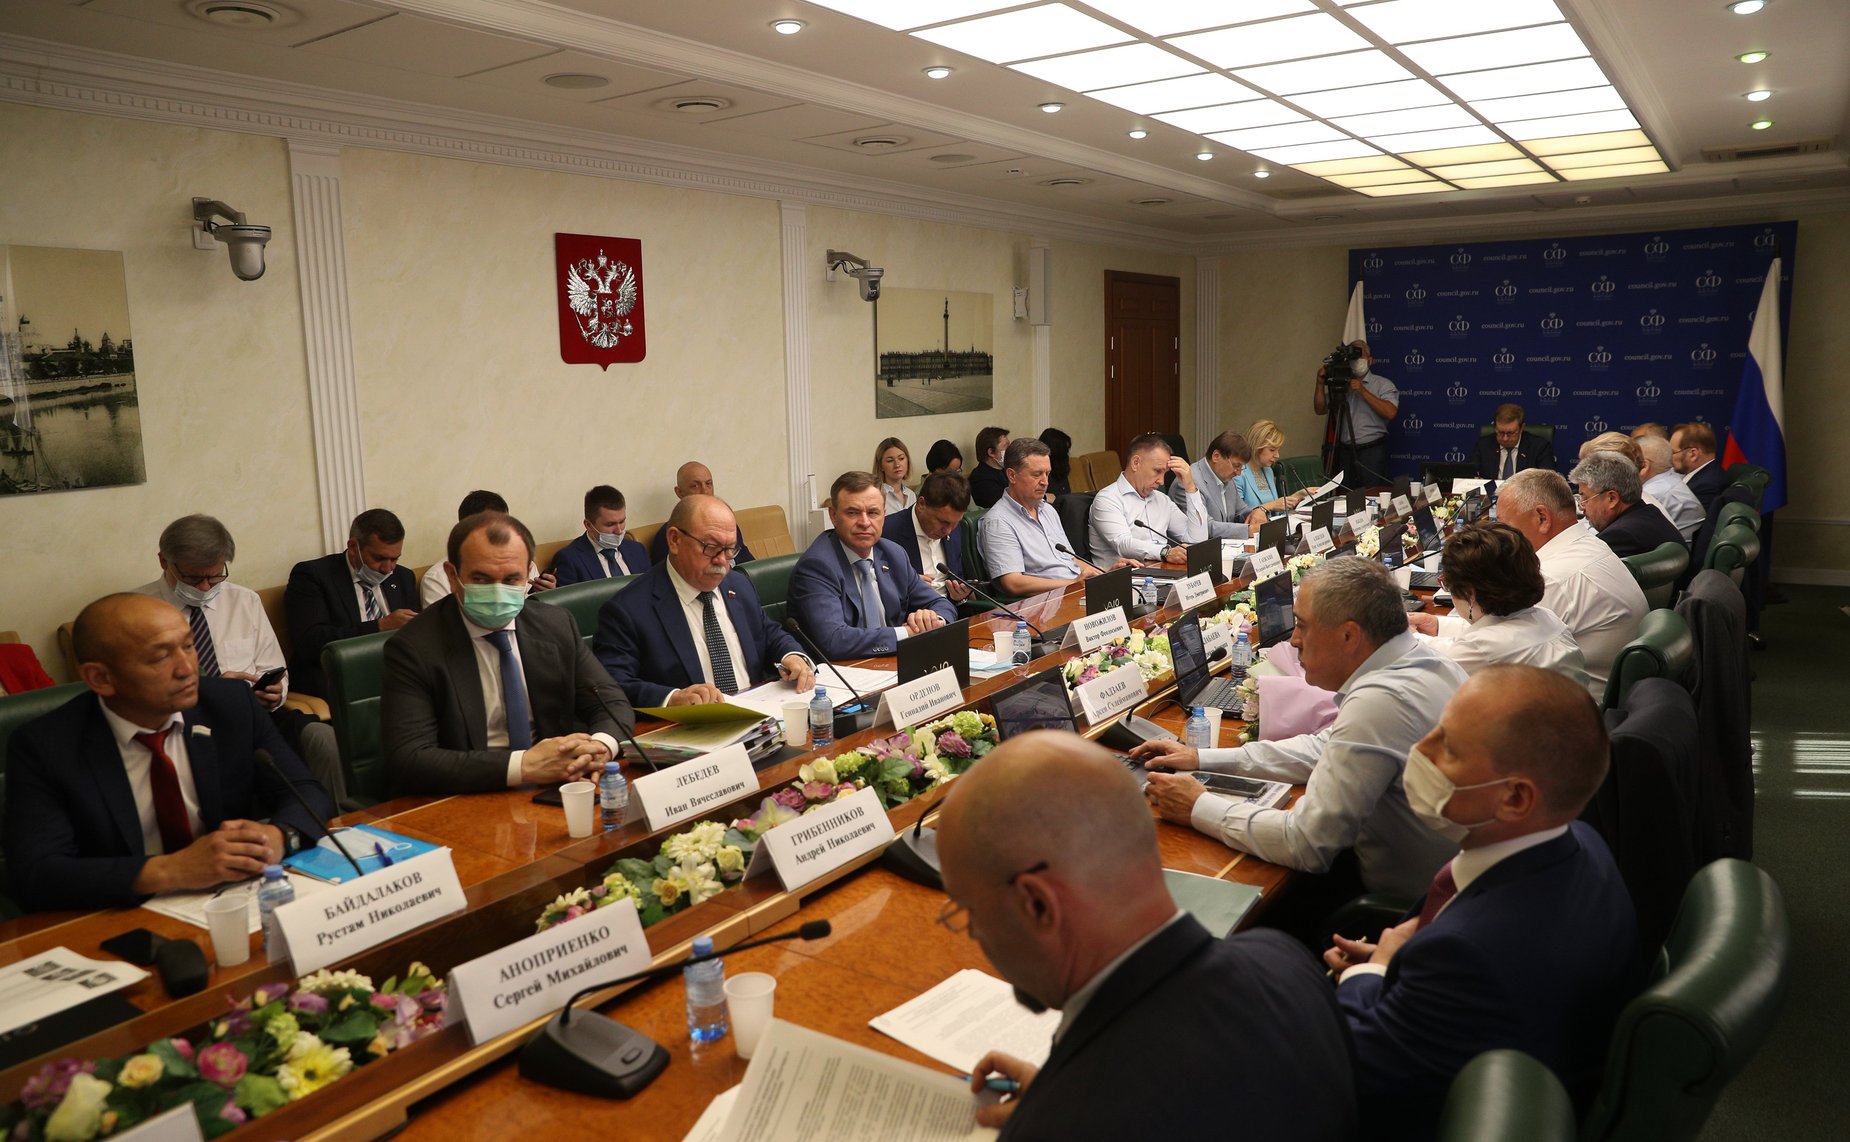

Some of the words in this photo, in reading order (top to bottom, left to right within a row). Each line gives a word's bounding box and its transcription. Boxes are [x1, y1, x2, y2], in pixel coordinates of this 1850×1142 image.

[1644, 241, 1669, 254] СФ
[1683, 240, 1735, 250] council.gov.ru
[1483, 253, 1527, 261] council.gov.ru
[1544, 248, 1566, 260] СФ
[1579, 248, 1626, 256] council.gov.ru
[1364, 257, 1383, 269] СФ
[1394, 257, 1435, 266] council.gov.ru
[1450, 253, 1471, 265] СФ
[1592, 280, 1615, 293] СФ
[1628, 281, 1677, 290] council.gov.ru
[1696, 275, 1722, 288] СФ
[1406, 288, 1426, 301] СФ
[1437, 289, 1479, 297] council.gov.ru
[1495, 284, 1517, 297] СФ
[1529, 286, 1574, 294] council.gov.ru
[1449, 319, 1469, 332] СФ
[1481, 321, 1525, 330] council.gov.ru
[1541, 317, 1563, 330] СФ
[1576, 318, 1623, 327] council.gov.ru
[1641, 314, 1665, 327] СФ
[1678, 315, 1729, 324] council.gov.ru
[1393, 323, 1434, 331] council.gov.ru
[1405, 354, 1425, 365] СФ
[1493, 352, 1515, 364] СФ
[1526, 355, 1571, 363] council.gov.ru
[1588, 351, 1611, 364] СФ
[1624, 352, 1672, 361] council.gov.ru
[1691, 348, 1716, 362] СФ
[1447, 386, 1467, 399] СФ
[1479, 389, 1522, 397] council.gov.ru
[1538, 386, 1560, 399] СФ
[1573, 389, 1619, 397] council.gov.ru
[1636, 385, 1661, 399] СФ
[1674, 388, 1723, 396] council.gov.ru
[1403, 418, 1423, 430] СФ
[1585, 421, 1608, 433] СФ
[1390, 453, 1430, 461] council.gov.ru
[1445, 452, 1465, 463] СФ
[1084, 614, 1116, 630] НОВОЖИЛОВ
[1086, 634, 1100, 642] Виктор
[910, 683, 940, 701] ОРДЕНОВ
[1100, 682, 1126, 699] ФАДЗАЕВ
[900, 702, 929, 719] Геннадий
[929, 691, 956, 707] Иванович
[676, 765, 720, 788] ЛЕБЕДЕВ
[665, 804, 688, 817] Иван
[690, 782, 745, 807] Вячеславович
[791, 807, 864, 846] ГРИБЕННИКОВ
[796, 843, 825, 865] Андрей
[827, 822, 876, 849] Николаевич
[324, 872, 422, 920] БАЙДАЛАКОВ
[317, 920, 365, 946] Рустам
[368, 887, 442, 924] Николаевич
[499, 926, 610, 983] АНОПРИЕНКО
[494, 981, 542, 1009] Сергей
[547, 945, 628, 988] Михайлович
